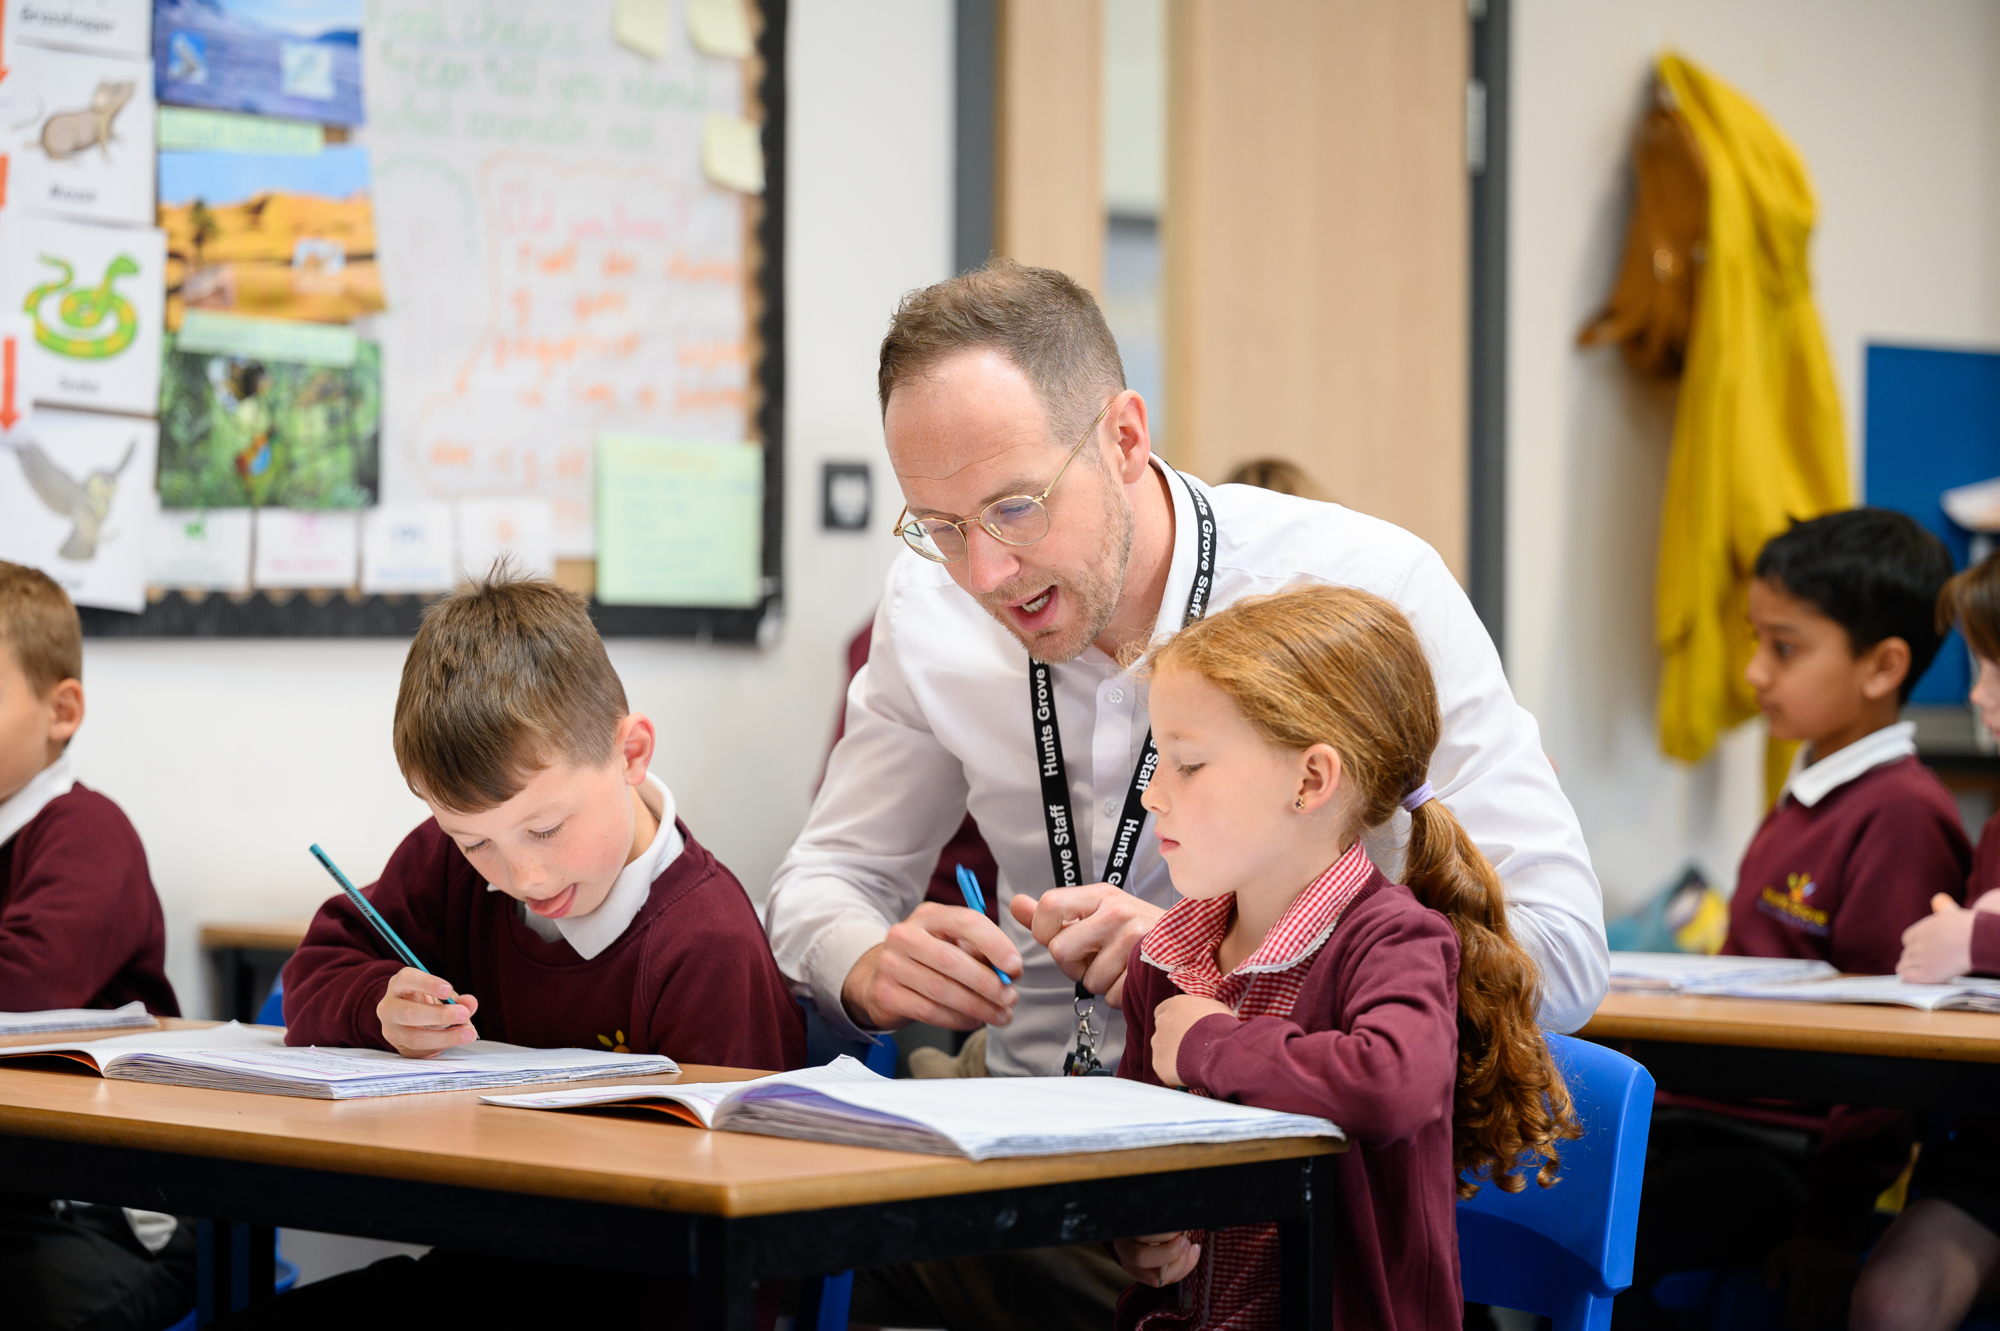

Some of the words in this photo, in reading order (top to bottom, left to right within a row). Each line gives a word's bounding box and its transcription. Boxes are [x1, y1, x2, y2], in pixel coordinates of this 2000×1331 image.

[1202, 519, 1214, 571] Grove
[1190, 575, 1209, 618] Staff
[1036, 668, 1051, 721] Grove
[1040, 724, 1059, 777] Hunts
[1135, 752, 1160, 792] Staff
[1049, 804, 1070, 846] Staff
[1112, 818, 1140, 868] Hunts
[1060, 849, 1077, 887] rove
